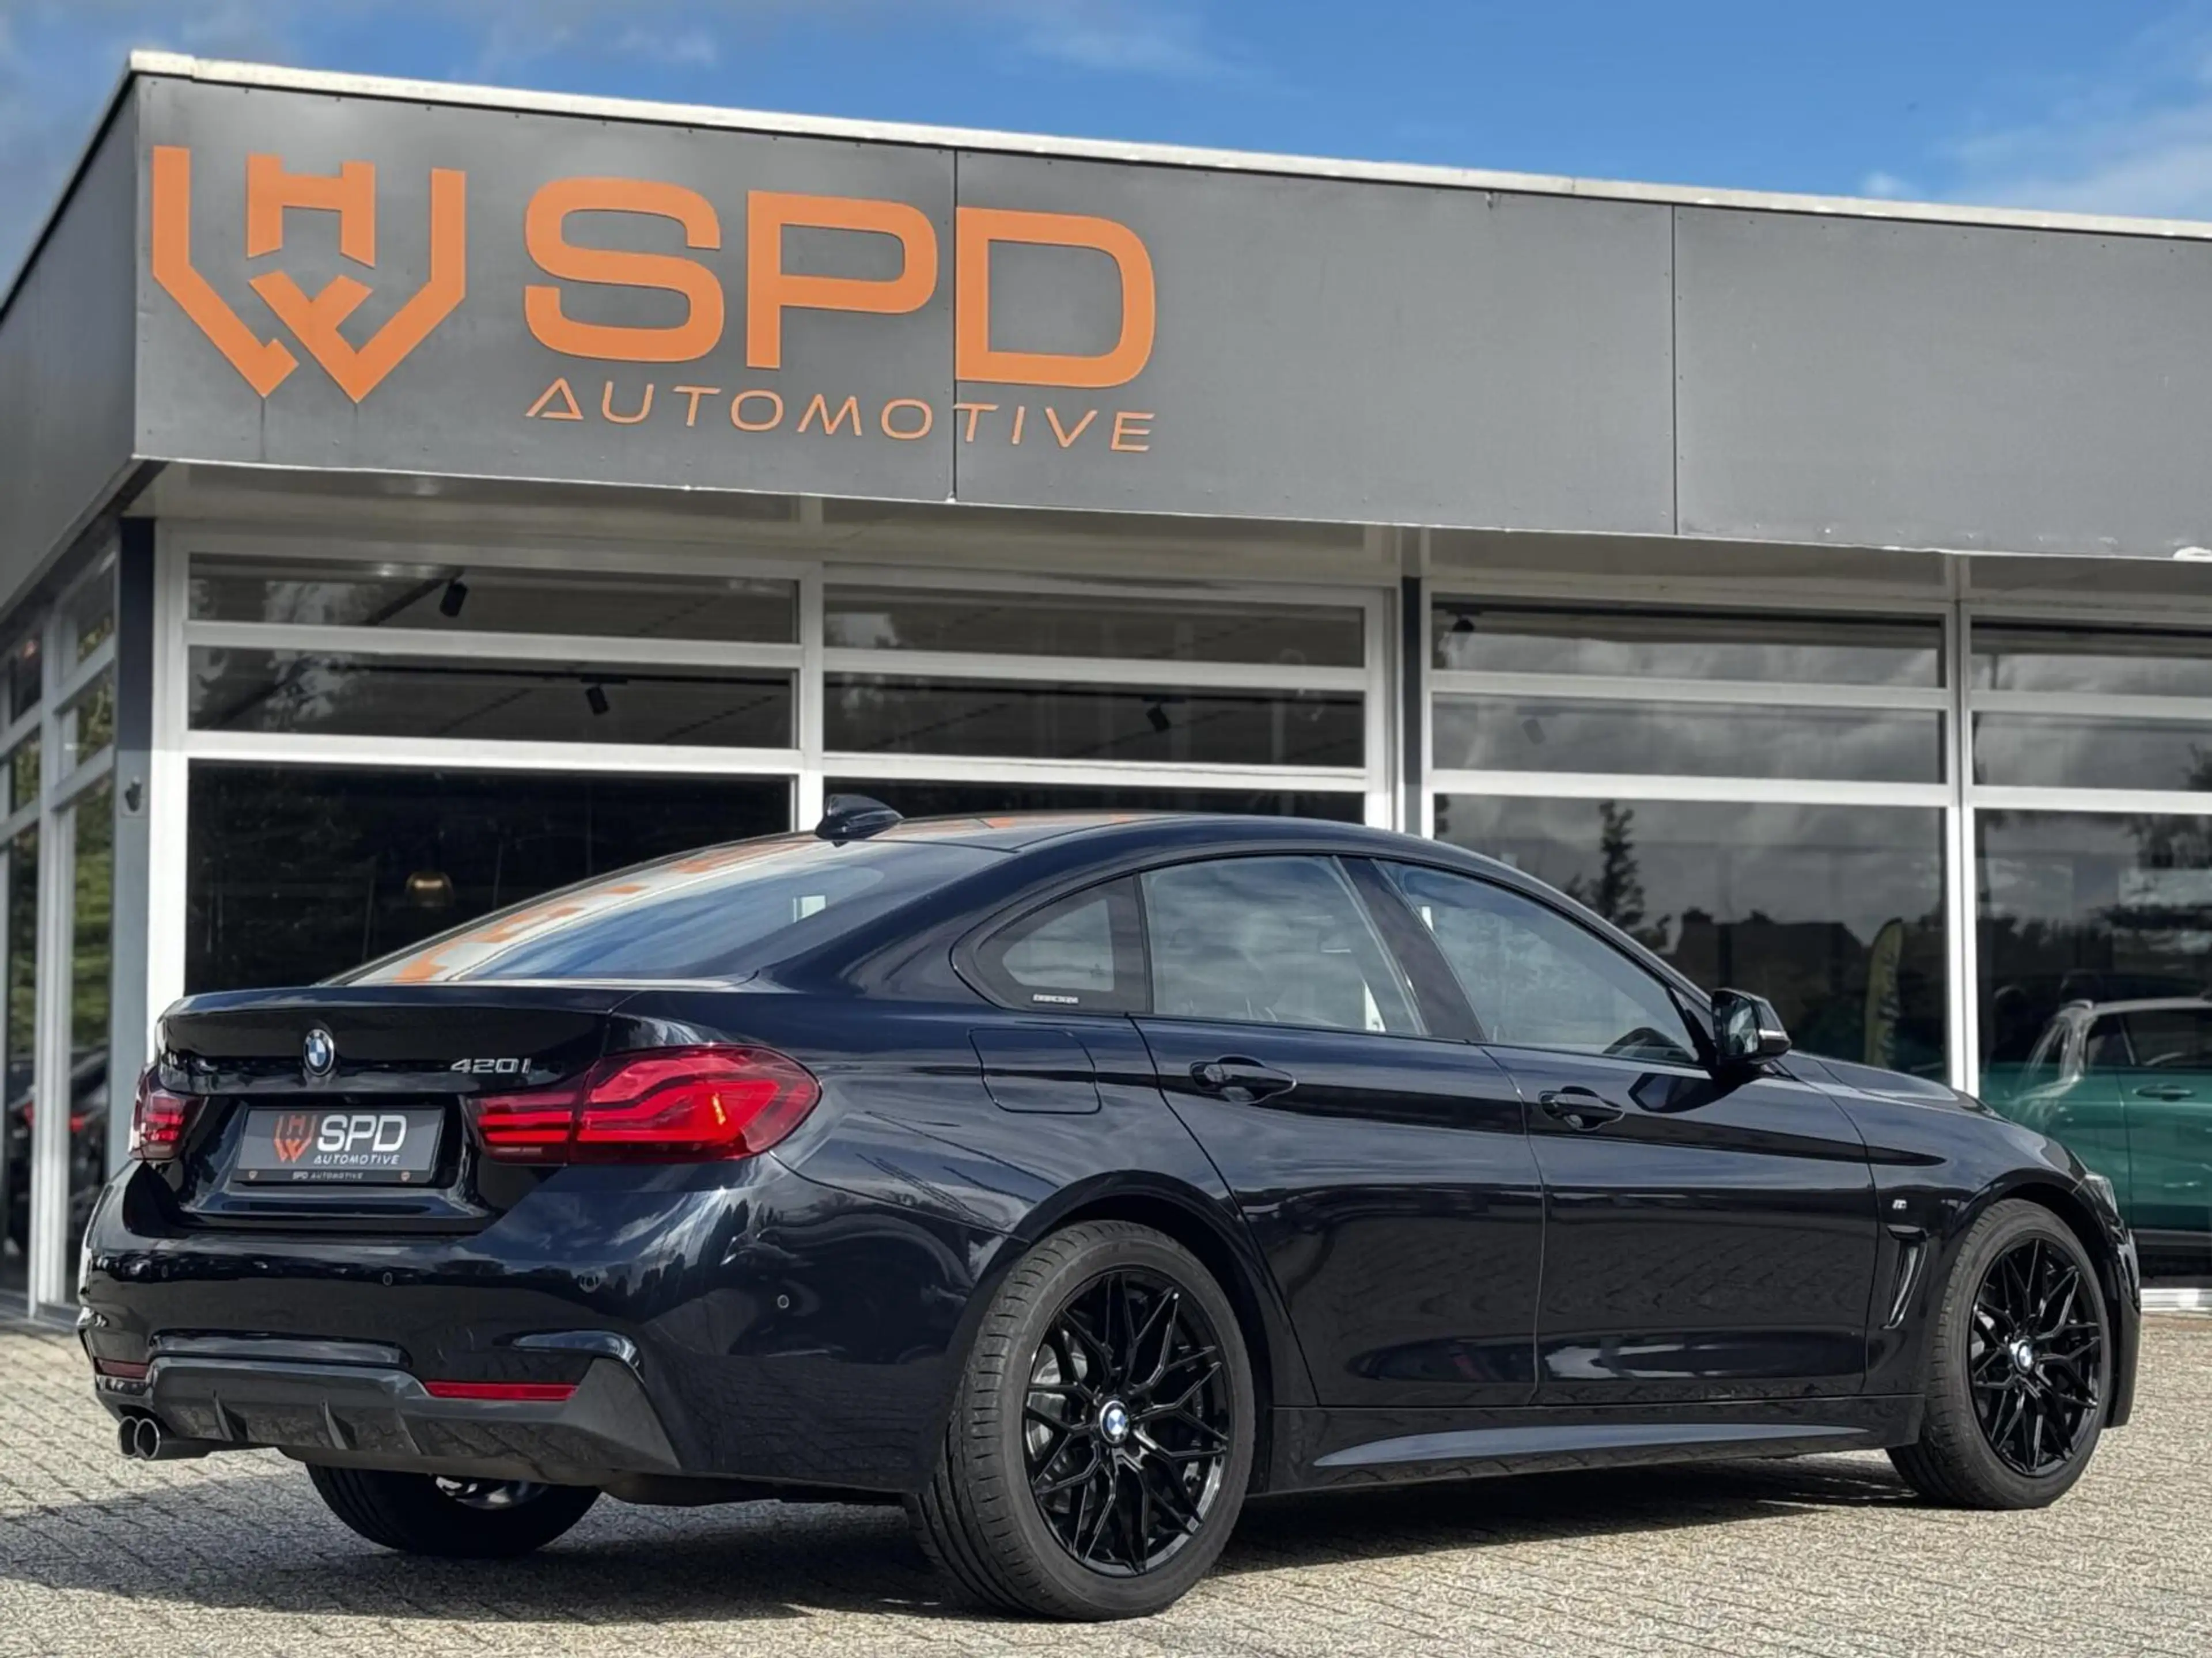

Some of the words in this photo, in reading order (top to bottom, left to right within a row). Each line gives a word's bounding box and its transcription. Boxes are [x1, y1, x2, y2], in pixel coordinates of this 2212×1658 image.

[526, 177, 1156, 388] SPD
[525, 377, 1156, 452] AUTOMOTIVE
[314, 1154, 400, 1164] AUTOMOTIVE
[317, 1114, 407, 1152] SPD
